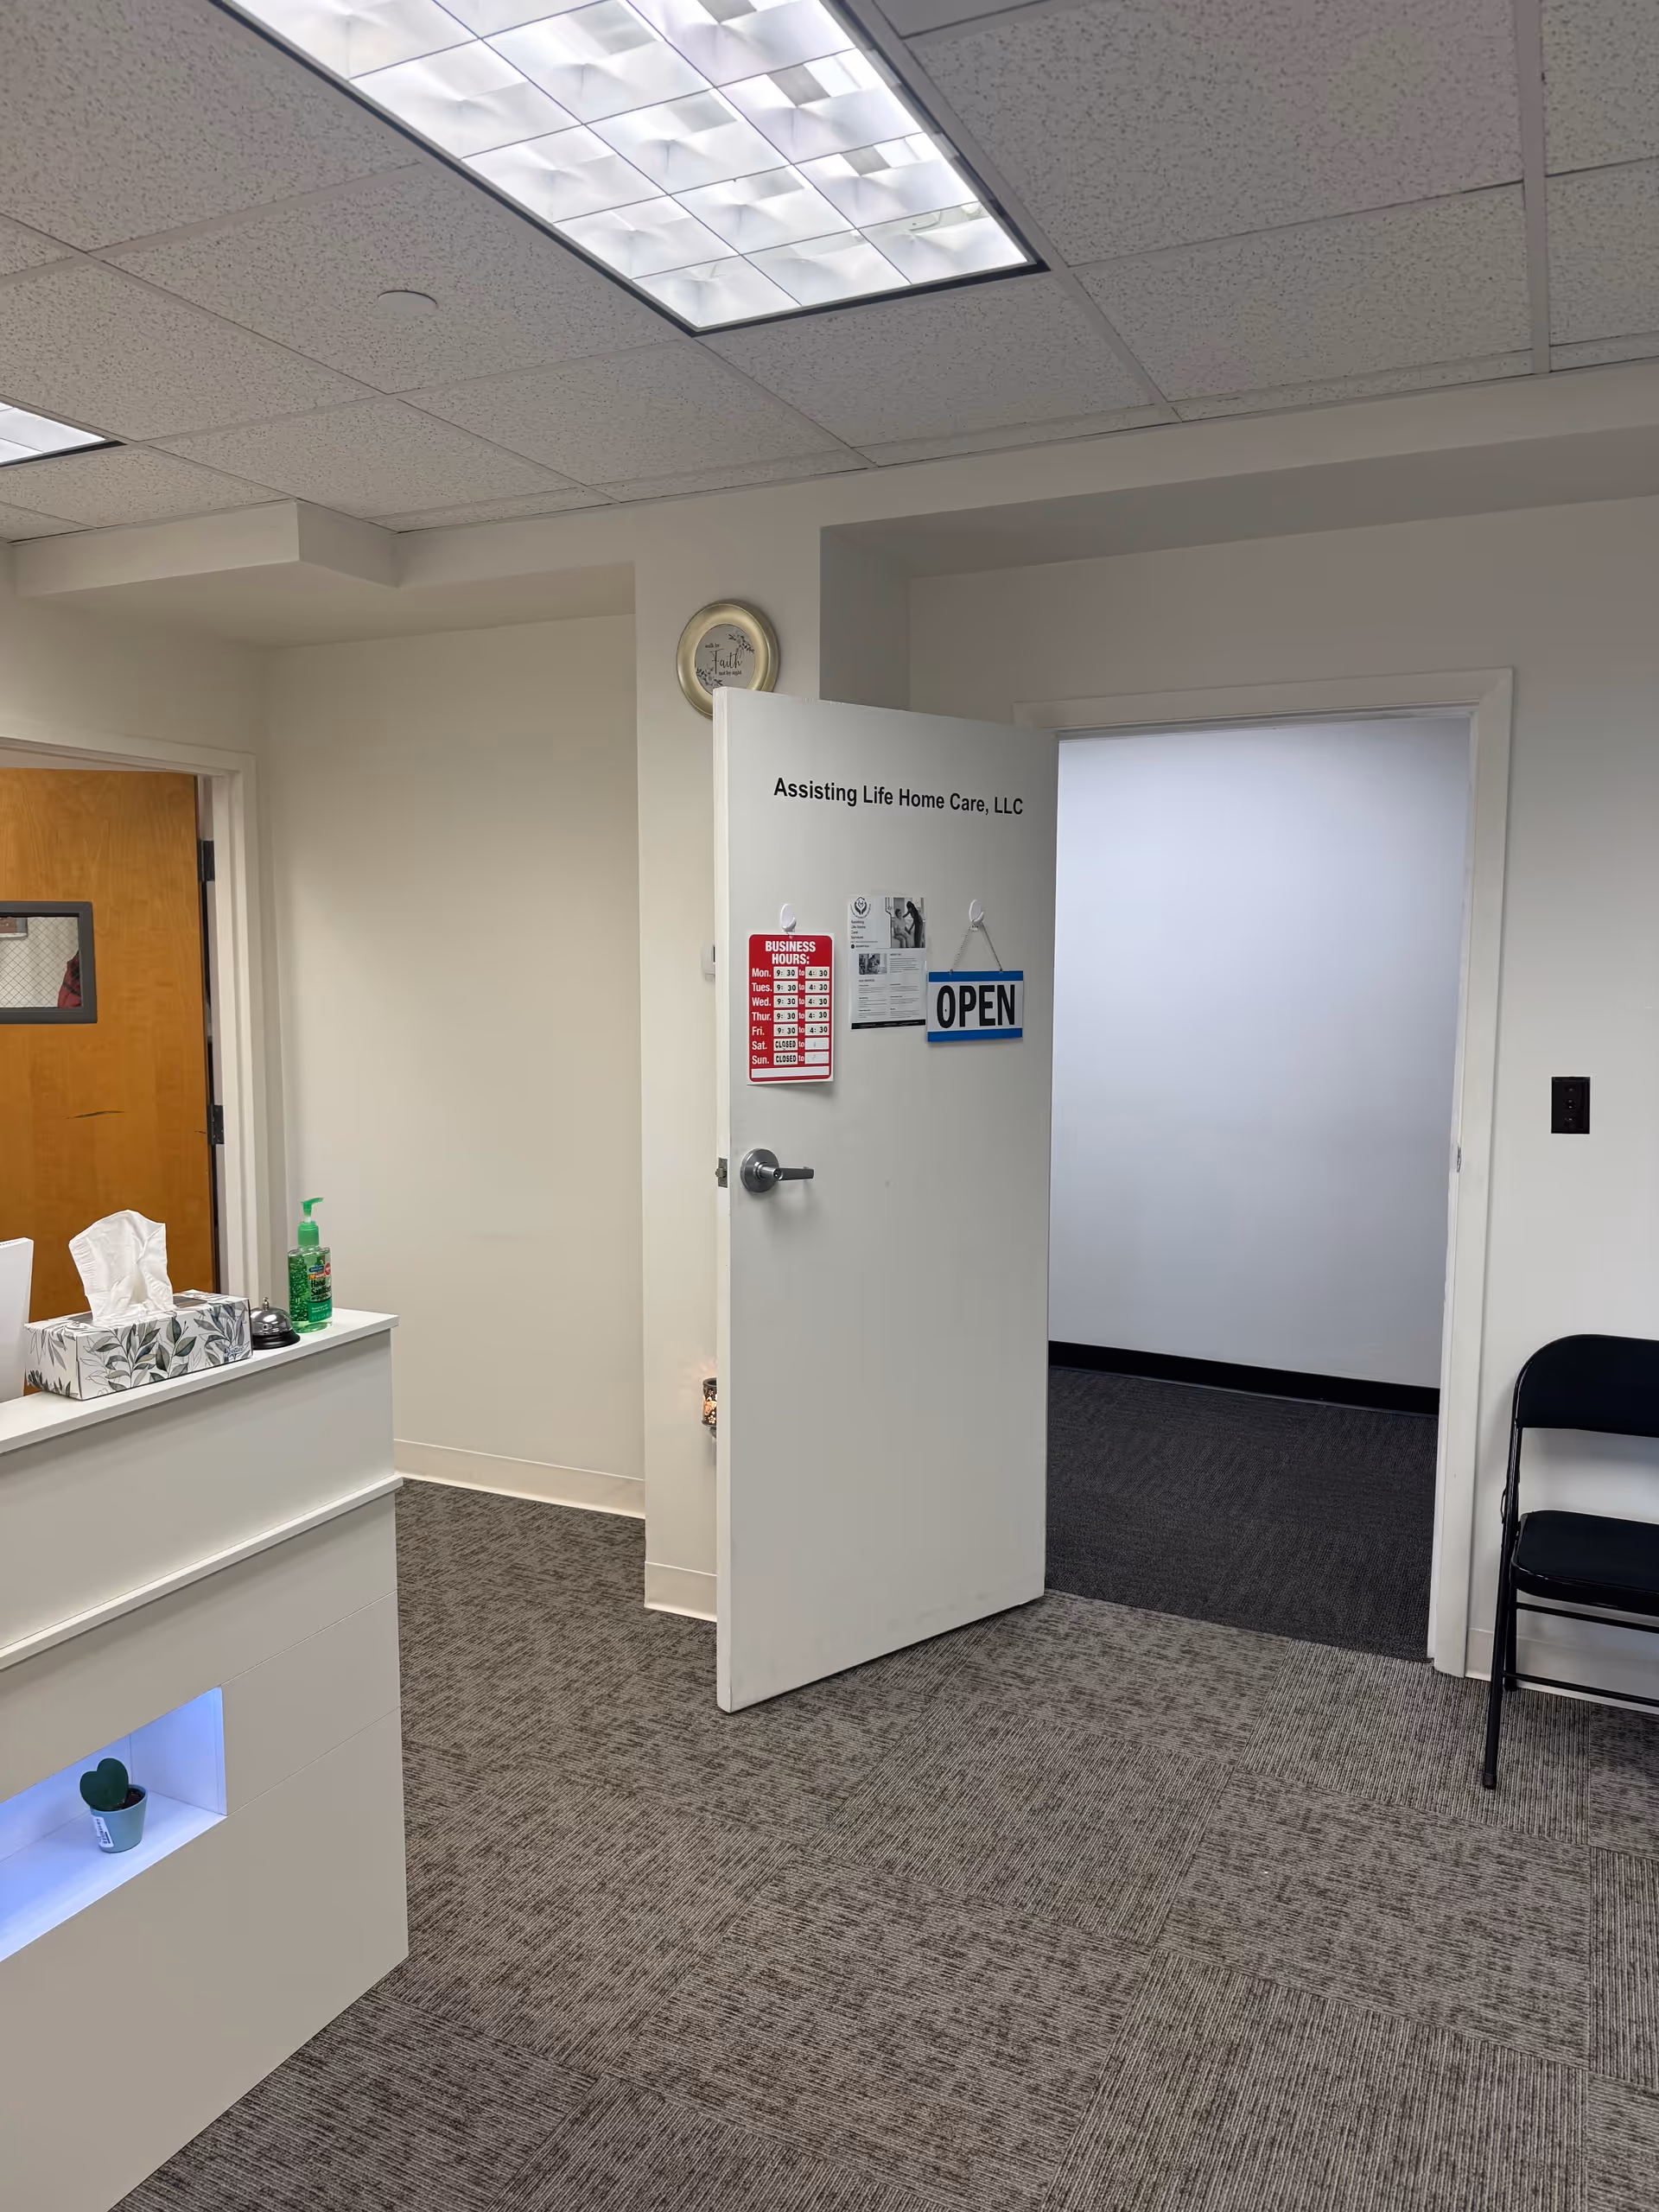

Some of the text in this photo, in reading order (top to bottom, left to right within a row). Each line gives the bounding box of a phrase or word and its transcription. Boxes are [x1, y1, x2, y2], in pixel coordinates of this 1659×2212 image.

[709, 648, 742, 675] Faith
[773, 777, 1023, 816] Assisting Life Home Care, LLC
[765, 940, 816, 952] BUSINESS
[772, 953, 810, 964] HOURS:
[752, 968, 772, 977] Mon.
[751, 982, 772, 992] Tues.
[752, 997, 772, 1007] Wed.
[937, 984, 1015, 1029] OPEN
[751, 1012, 772, 1021] Thur.
[752, 1026, 765, 1035] Fri.
[752, 1040, 767, 1050] Sat.
[752, 1055, 770, 1065] Sun.
[311, 1277, 326, 1288] Hand
